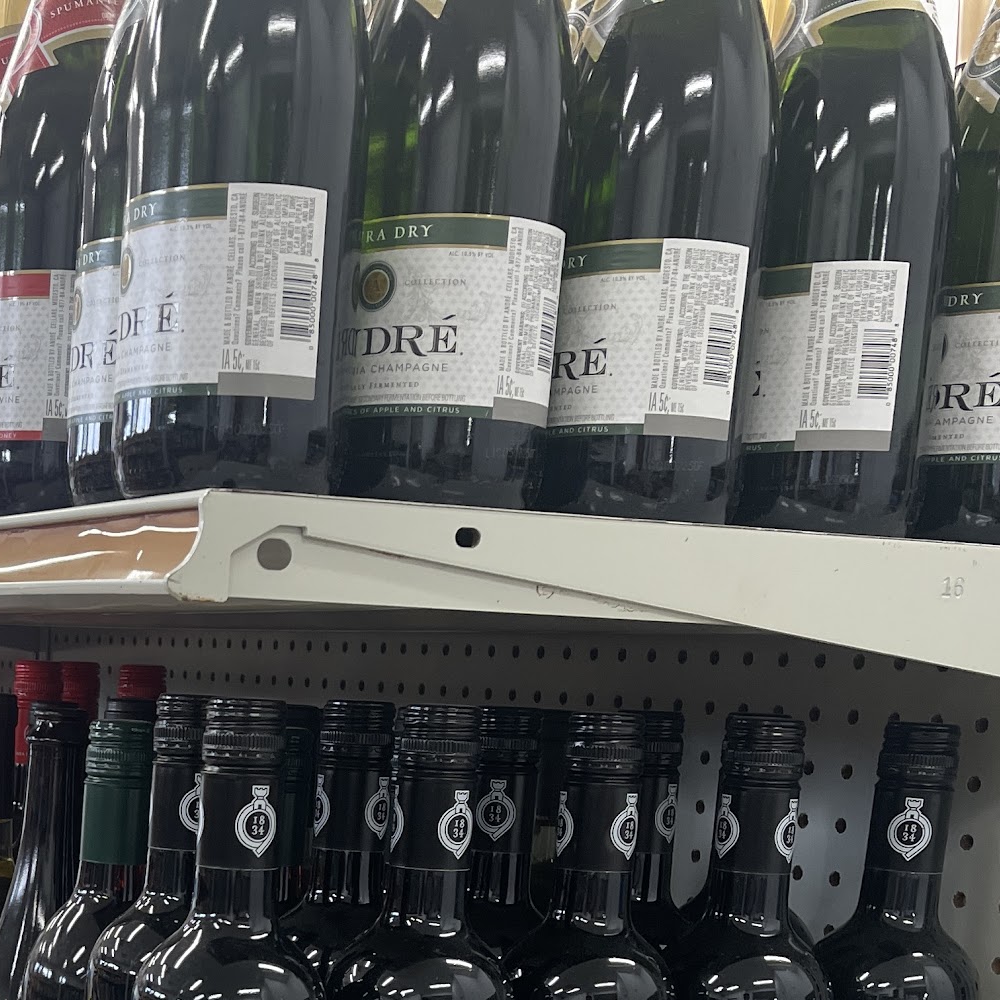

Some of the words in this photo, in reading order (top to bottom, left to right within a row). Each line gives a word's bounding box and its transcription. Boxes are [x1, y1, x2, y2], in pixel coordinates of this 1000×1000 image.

[133, 202, 157, 219] DRY
[394, 224, 434, 240] DRY
[83, 249, 103, 265] DRY
[404, 278, 466, 287] COLLECTION
[947, 292, 984, 307] DRY
[370, 362, 449, 374] CHAMPAGNE
[154, 386, 183, 395] CITRUS
[373, 406, 400, 414] APPLE
[403, 405, 424, 413] AND
[426, 405, 460, 414] CITRUS
[934, 415, 994, 427] AMPAGNE
[558, 427, 575, 435] AND
[577, 425, 609, 434] CITRUS
[940, 575, 965, 600] 16
